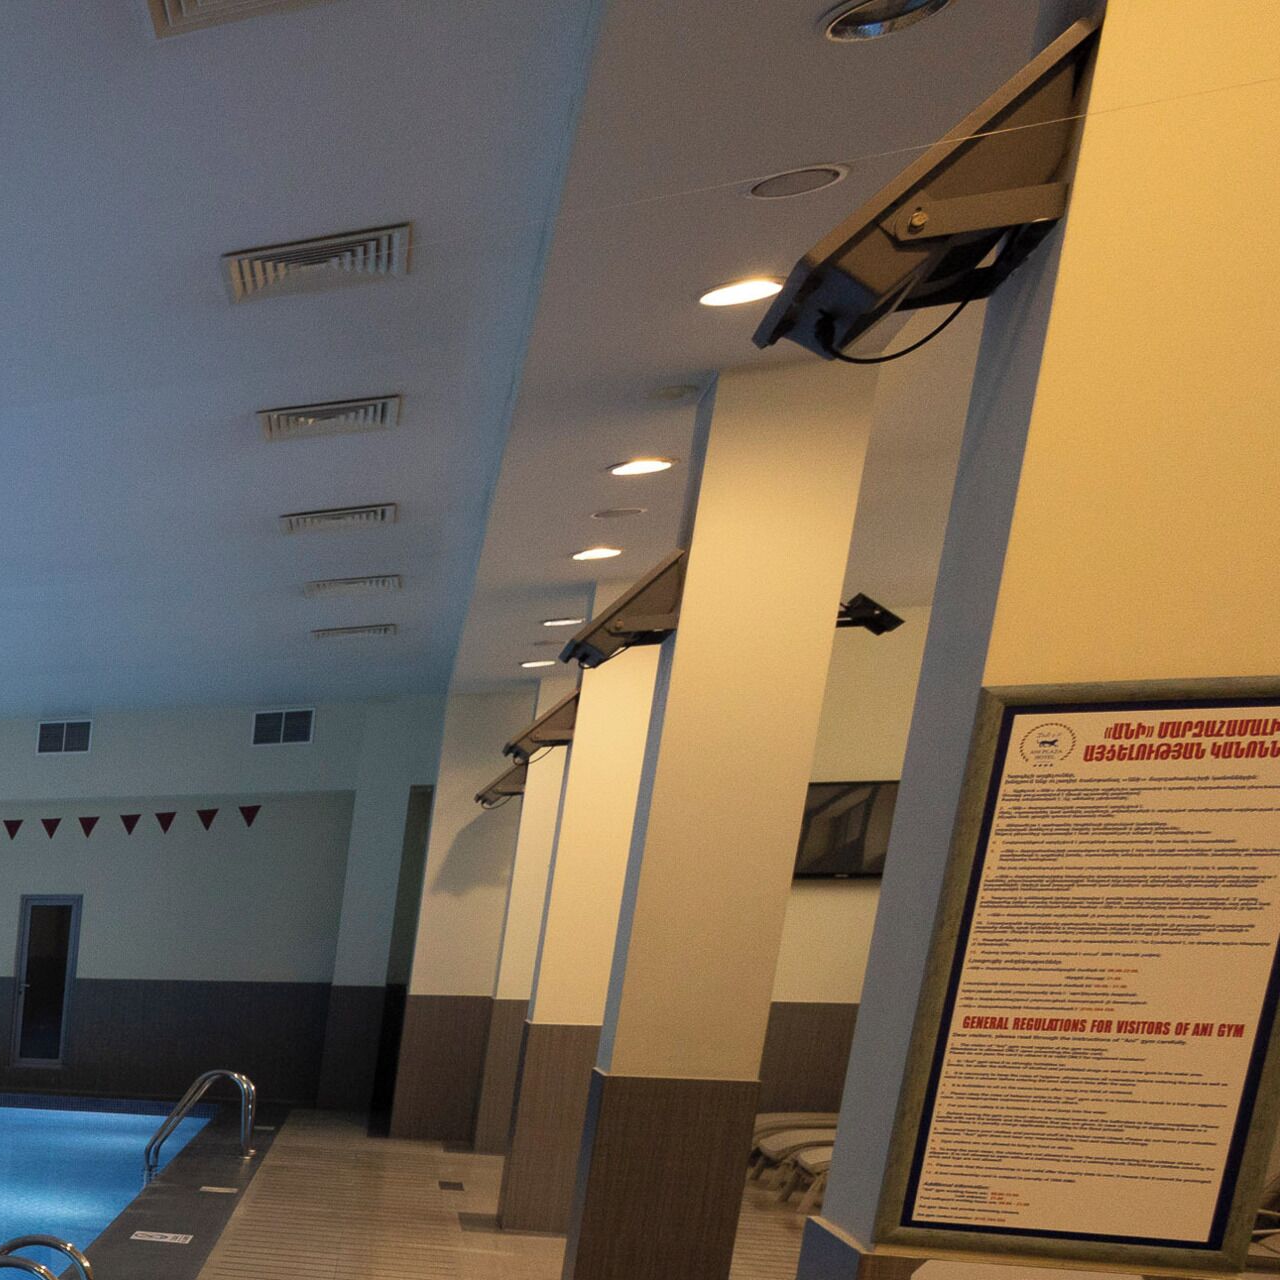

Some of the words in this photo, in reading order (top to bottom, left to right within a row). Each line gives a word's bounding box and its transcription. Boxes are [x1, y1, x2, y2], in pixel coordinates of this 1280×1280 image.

[962, 1015, 1009, 1030] GENERAL
[1012, 1017, 1087, 1033] REGULATIONS
[1090, 1019, 1113, 1034] FOR
[1116, 1020, 1171, 1036] VISITORS
[1174, 1022, 1191, 1036] OF
[1191, 1022, 1214, 1037] ANI
[1217, 1023, 1245, 1038] GYM
